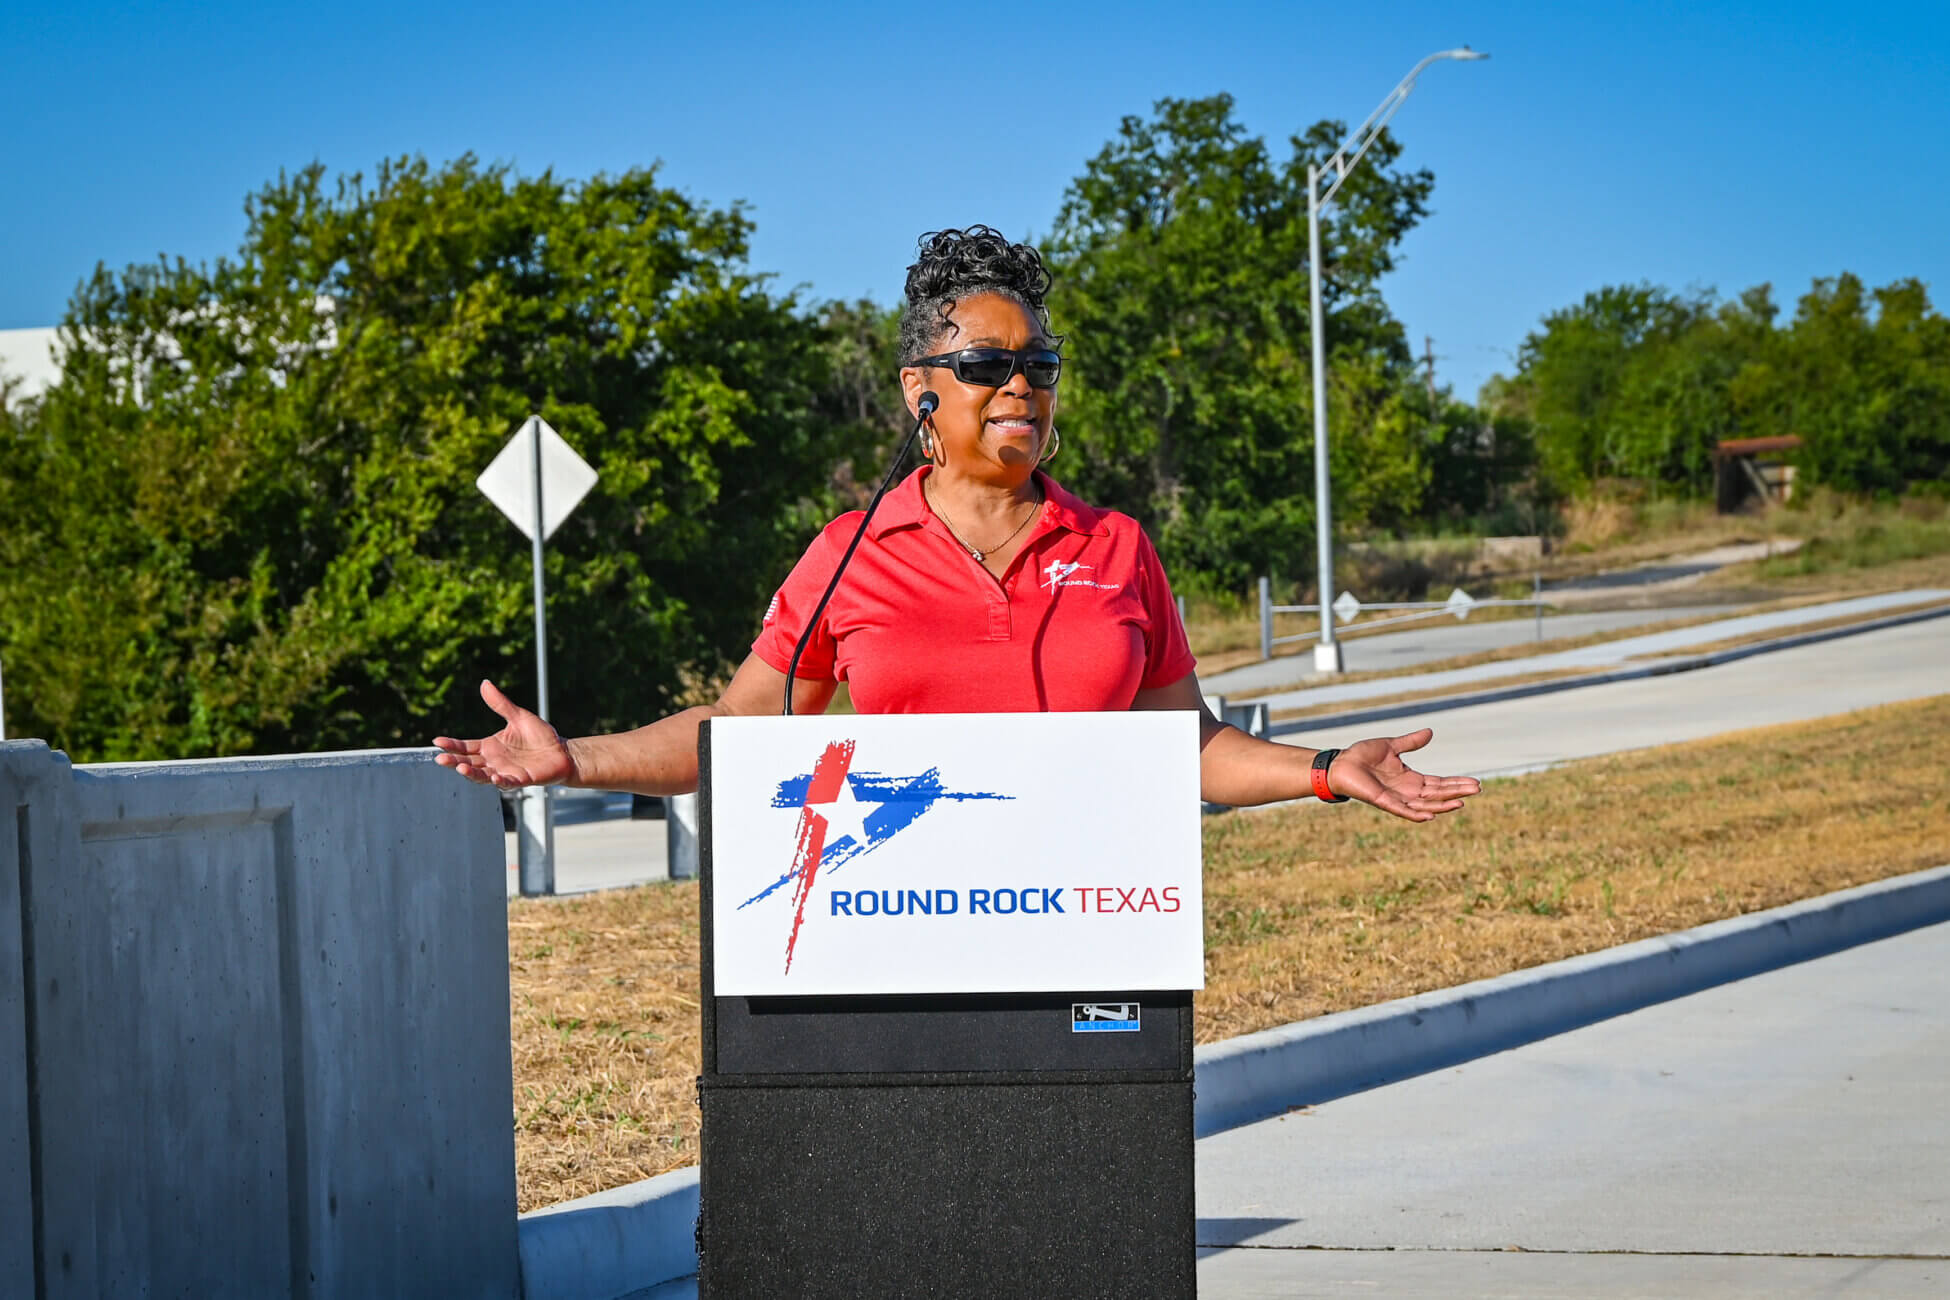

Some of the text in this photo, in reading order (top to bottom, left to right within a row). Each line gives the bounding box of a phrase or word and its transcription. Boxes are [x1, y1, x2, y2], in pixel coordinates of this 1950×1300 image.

[831, 886, 1181, 916] ROUND ROCK TEXAS
